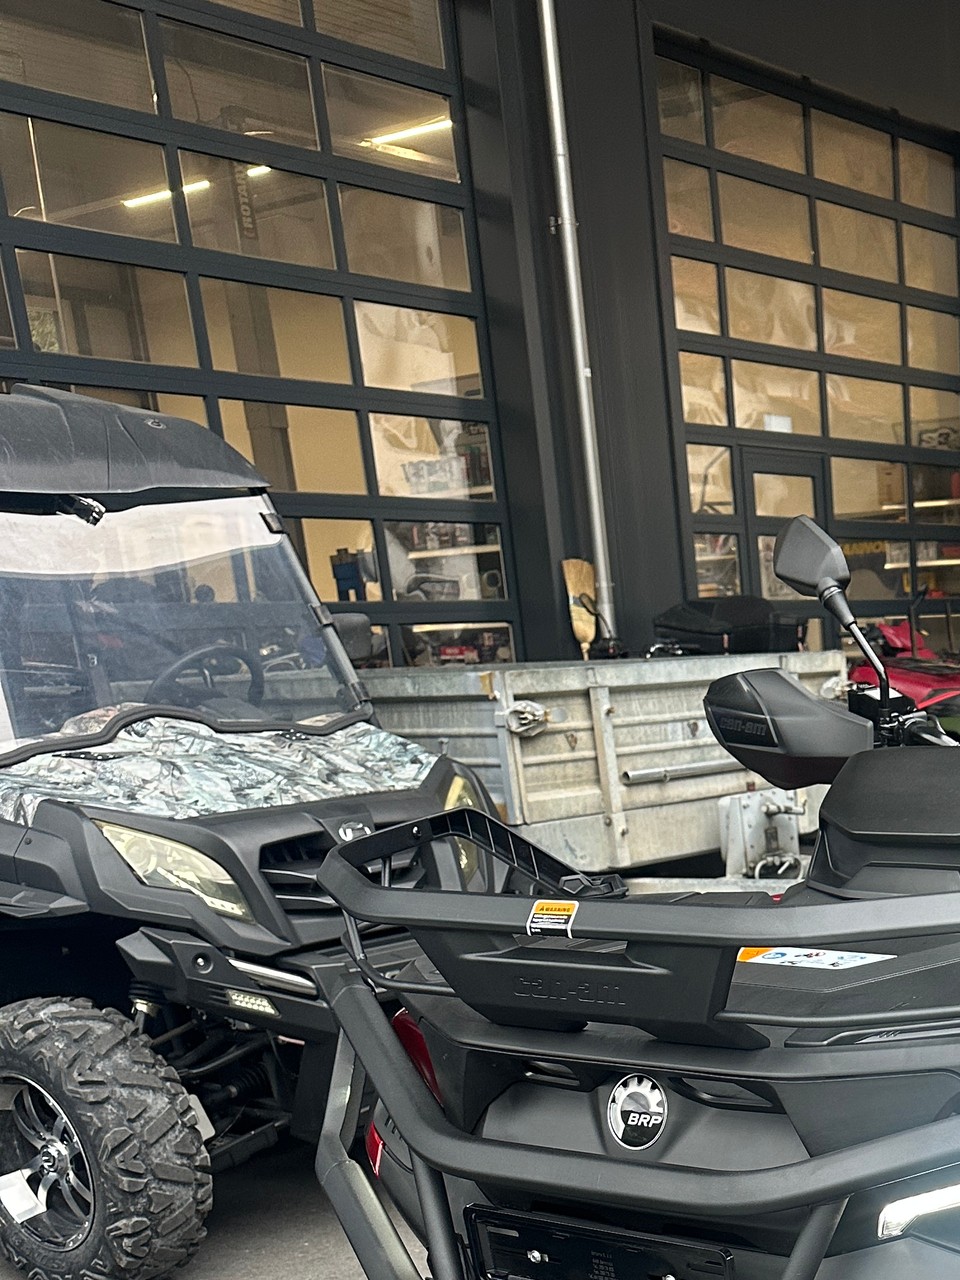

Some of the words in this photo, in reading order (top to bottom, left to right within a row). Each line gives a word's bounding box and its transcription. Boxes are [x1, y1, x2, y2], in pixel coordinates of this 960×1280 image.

[720, 717, 767, 736] can-am
[513, 977, 626, 1006] can-am
[627, 1112, 663, 1128] BRP
